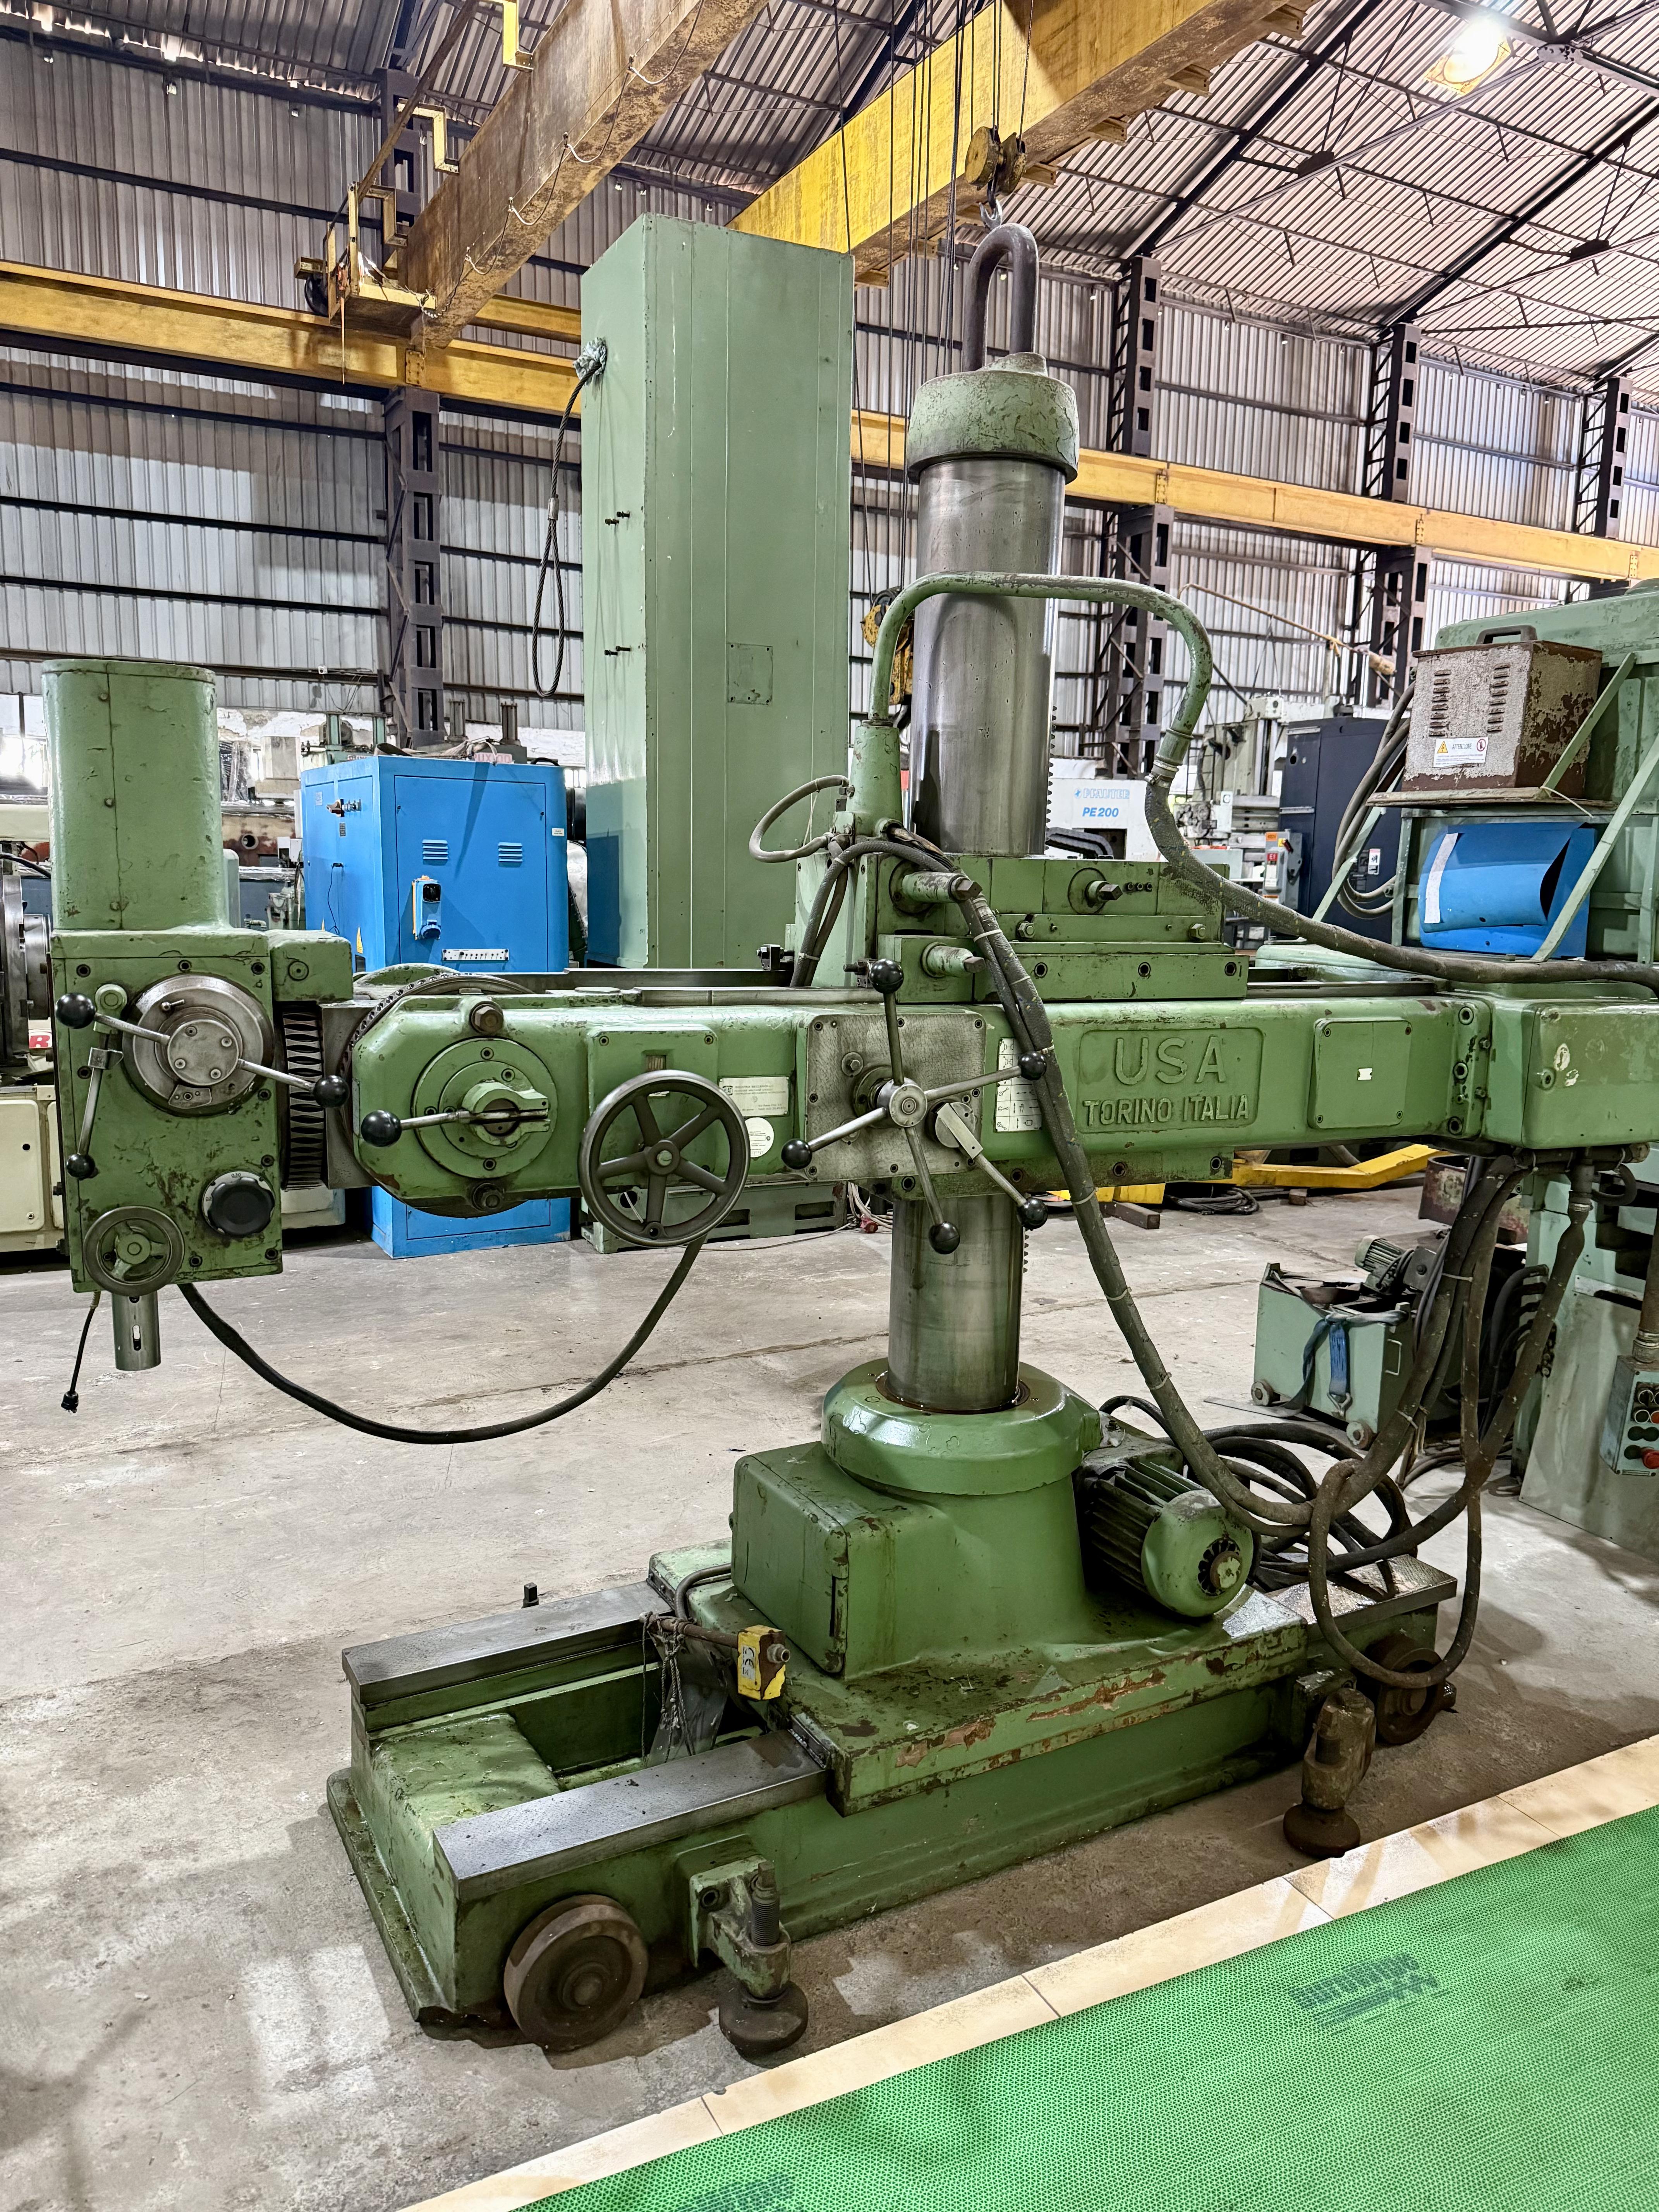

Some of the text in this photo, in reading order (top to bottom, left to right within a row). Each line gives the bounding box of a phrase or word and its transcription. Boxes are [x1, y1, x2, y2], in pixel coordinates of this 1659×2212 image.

[1083, 788, 1130, 799] PFAUTER
[1115, 1035, 1226, 1085] USA
[1082, 1094, 1249, 1126] TORINO ITALIA
